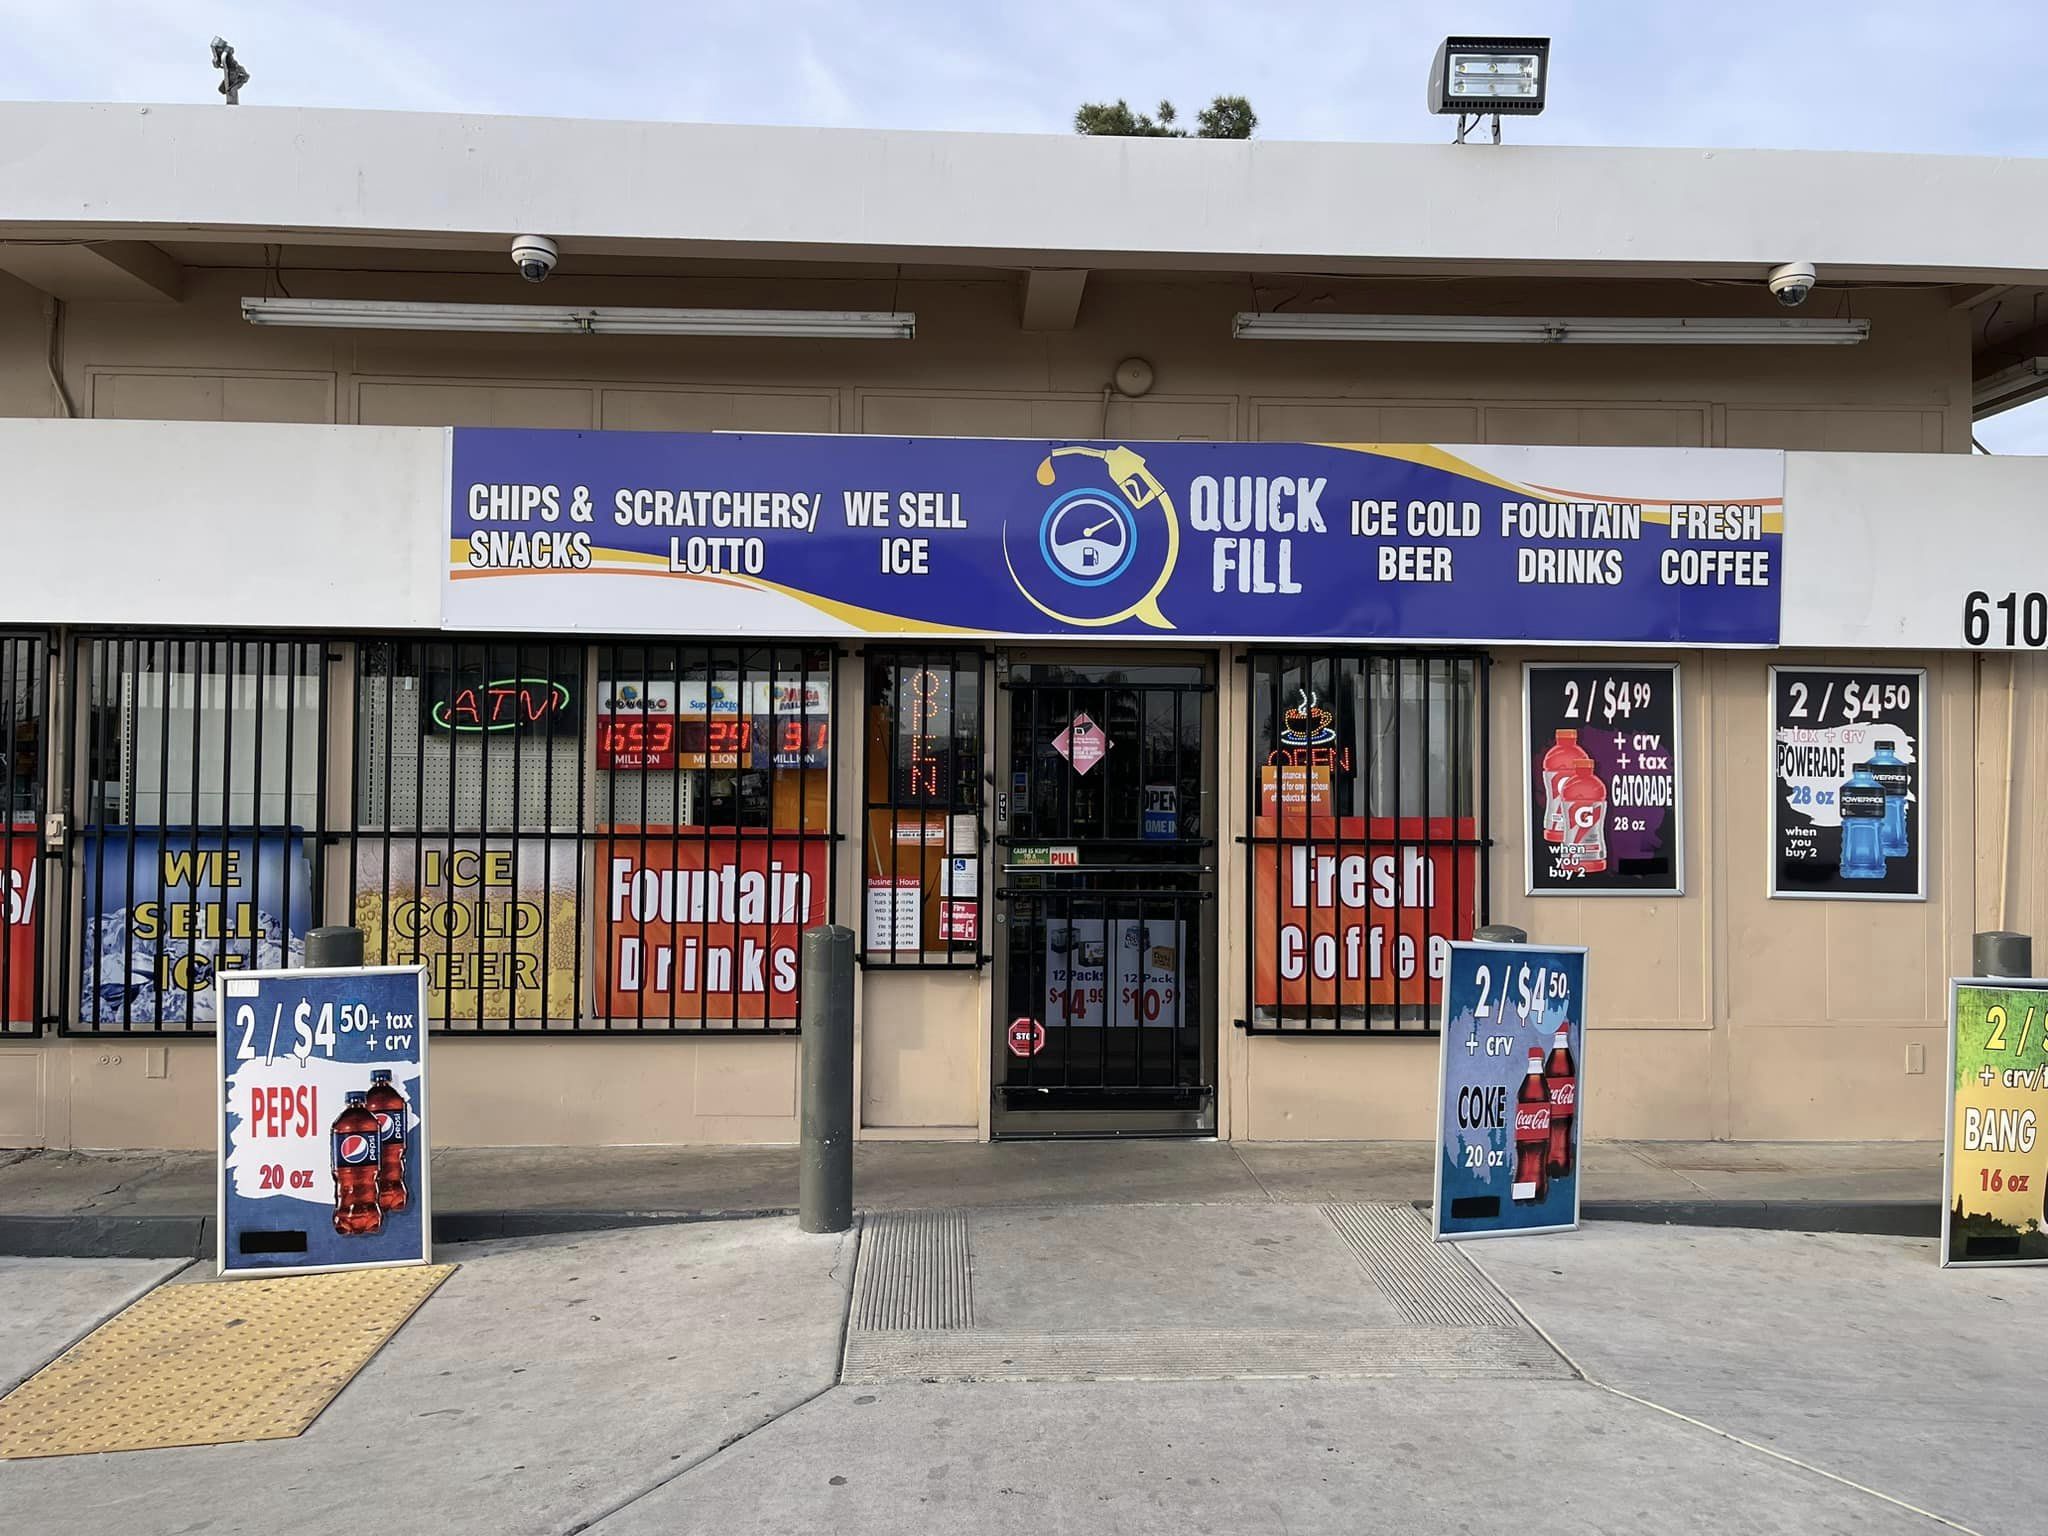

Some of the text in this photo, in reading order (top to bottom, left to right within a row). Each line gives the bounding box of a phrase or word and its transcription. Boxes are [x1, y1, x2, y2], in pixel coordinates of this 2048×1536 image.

[469, 484, 594, 523] CHIPS &
[614, 489, 821, 533] SCRATCHERS/
[844, 491, 967, 529] WE SELL
[1189, 475, 1327, 534] QUICK
[1350, 500, 1480, 538] ICE COLD
[1501, 502, 1641, 541] FOUNTAIN
[1669, 504, 1762, 542] FRESH
[469, 531, 592, 569] SNACKS
[669, 536, 764, 574] LOTTO
[881, 538, 929, 575] ICE
[1212, 538, 1302, 594] FILL
[1378, 545, 1452, 583] BEER
[1517, 547, 1624, 586] DRINKS
[1660, 549, 1769, 587] COFFEE
[444, 689, 559, 723] ATM
[1564, 680, 1579, 718] 2
[1789, 682, 1808, 717] 2
[911, 671, 940, 795] OPEN
[1633, 734, 1661, 751] crv
[1841, 728, 1865, 744] crv
[1638, 753, 1668, 770] tax
[1776, 744, 1845, 778] POWERADE
[1611, 775, 1673, 807] GATORADE
[1791, 785, 1834, 805] 28 oz
[1574, 806, 1594, 828] G
[1614, 817, 1646, 831] 28 oz
[1785, 826, 1817, 837] when
[1051, 852, 1076, 864] PULL
[1549, 844, 1585, 854] when
[1785, 847, 1817, 859] buy 2
[1790, 839, 1812, 849] you
[162, 849, 243, 888] WE
[425, 849, 514, 888] ICE
[1291, 845, 1436, 908] Fresh
[1549, 867, 1586, 880] buy 2
[1555, 858, 1579, 869] you
[611, 856, 812, 925] Fountain
[132, 900, 266, 939] SELL
[393, 900, 542, 939] COLD
[618, 936, 799, 993] Drinks
[1280, 924, 1446, 981] Coffee
[1053, 970, 1066, 981] 12
[1123, 974, 1138, 983] 12
[1474, 965, 1491, 1018] 2
[236, 1004, 256, 1060] 2
[386, 1011, 414, 1031] tax
[385, 1033, 412, 1051] crv
[1486, 1035, 1514, 1056] crv
[1984, 1004, 2008, 1052] 2
[251, 1085, 318, 1139] PEPSI
[394, 1113, 402, 1140] pepsi
[1457, 1084, 1507, 1131] COKE
[368, 1135, 377, 1161] pepsi
[1963, 1106, 2037, 1153] BANG
[1465, 1146, 1503, 1168] 20 oz
[260, 1164, 314, 1190] 20 oz
[1980, 1168, 2030, 1192] 16 oz
